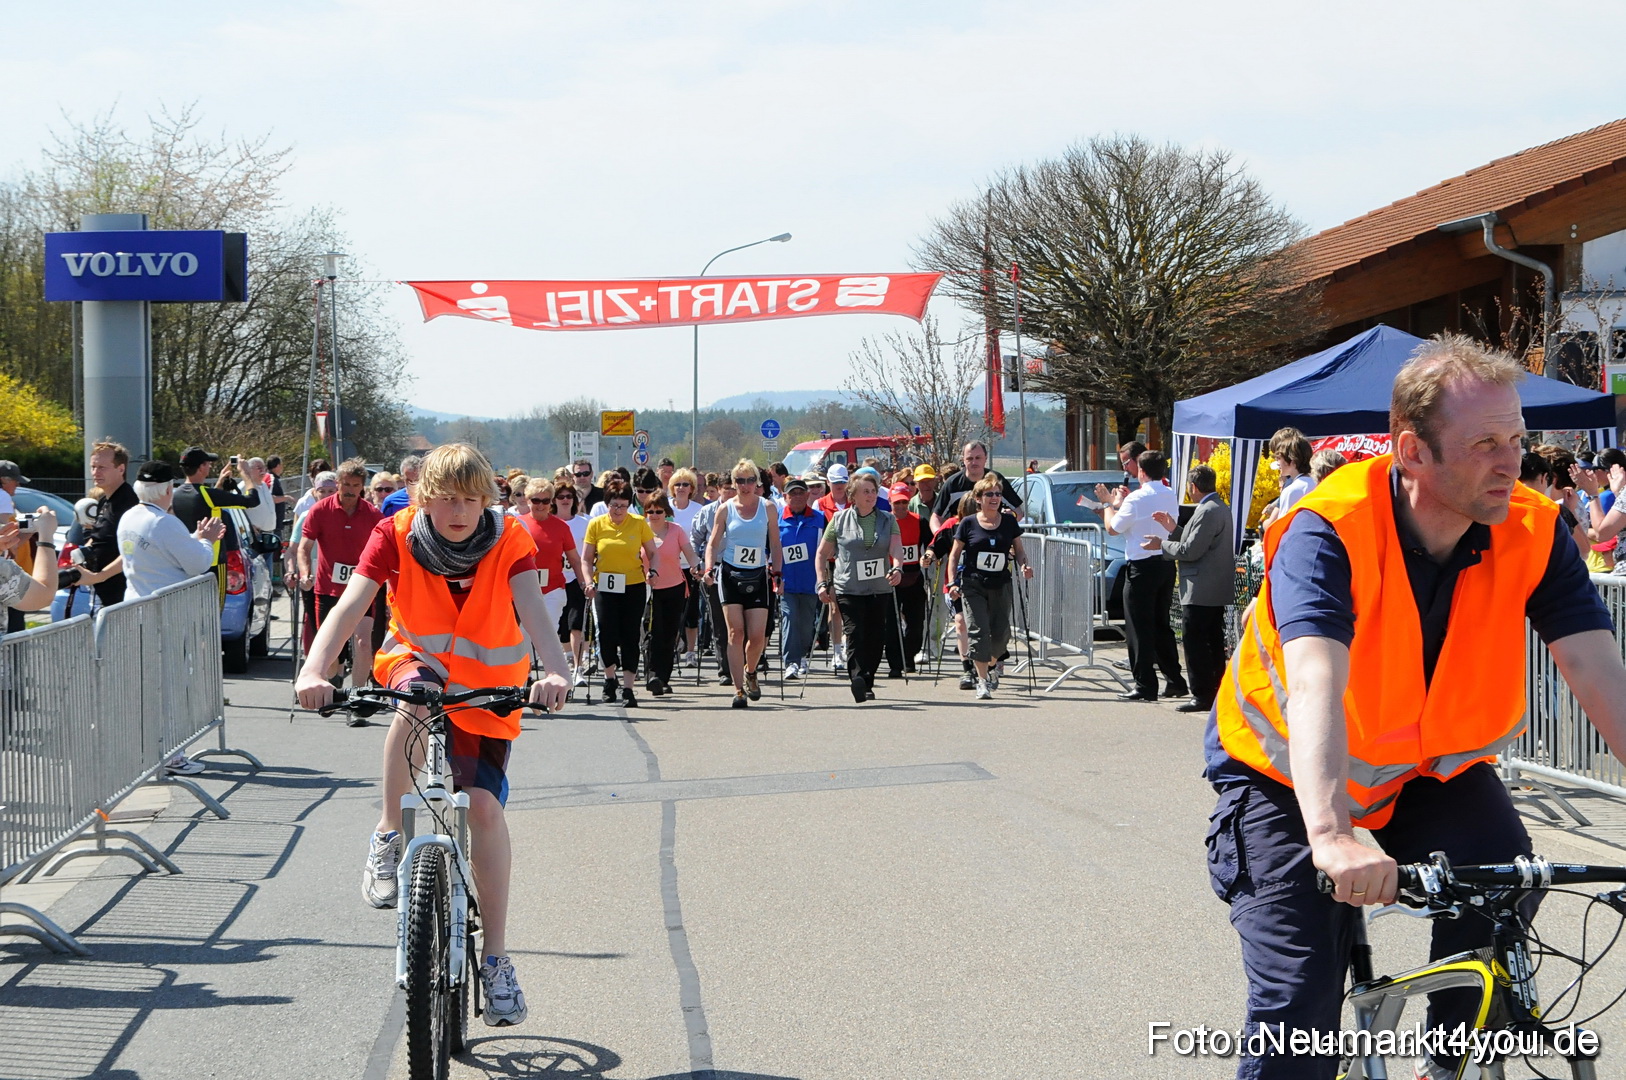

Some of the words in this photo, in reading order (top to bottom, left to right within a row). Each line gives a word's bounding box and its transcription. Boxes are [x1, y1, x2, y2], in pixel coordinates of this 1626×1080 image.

[61, 251, 198, 277] VOLVO
[637, 435, 646, 444] 60
[740, 548, 757, 564] 24
[787, 546, 803, 560] 29
[983, 553, 999, 569] 47
[864, 561, 879, 577] 57
[607, 575, 615, 590] 6
